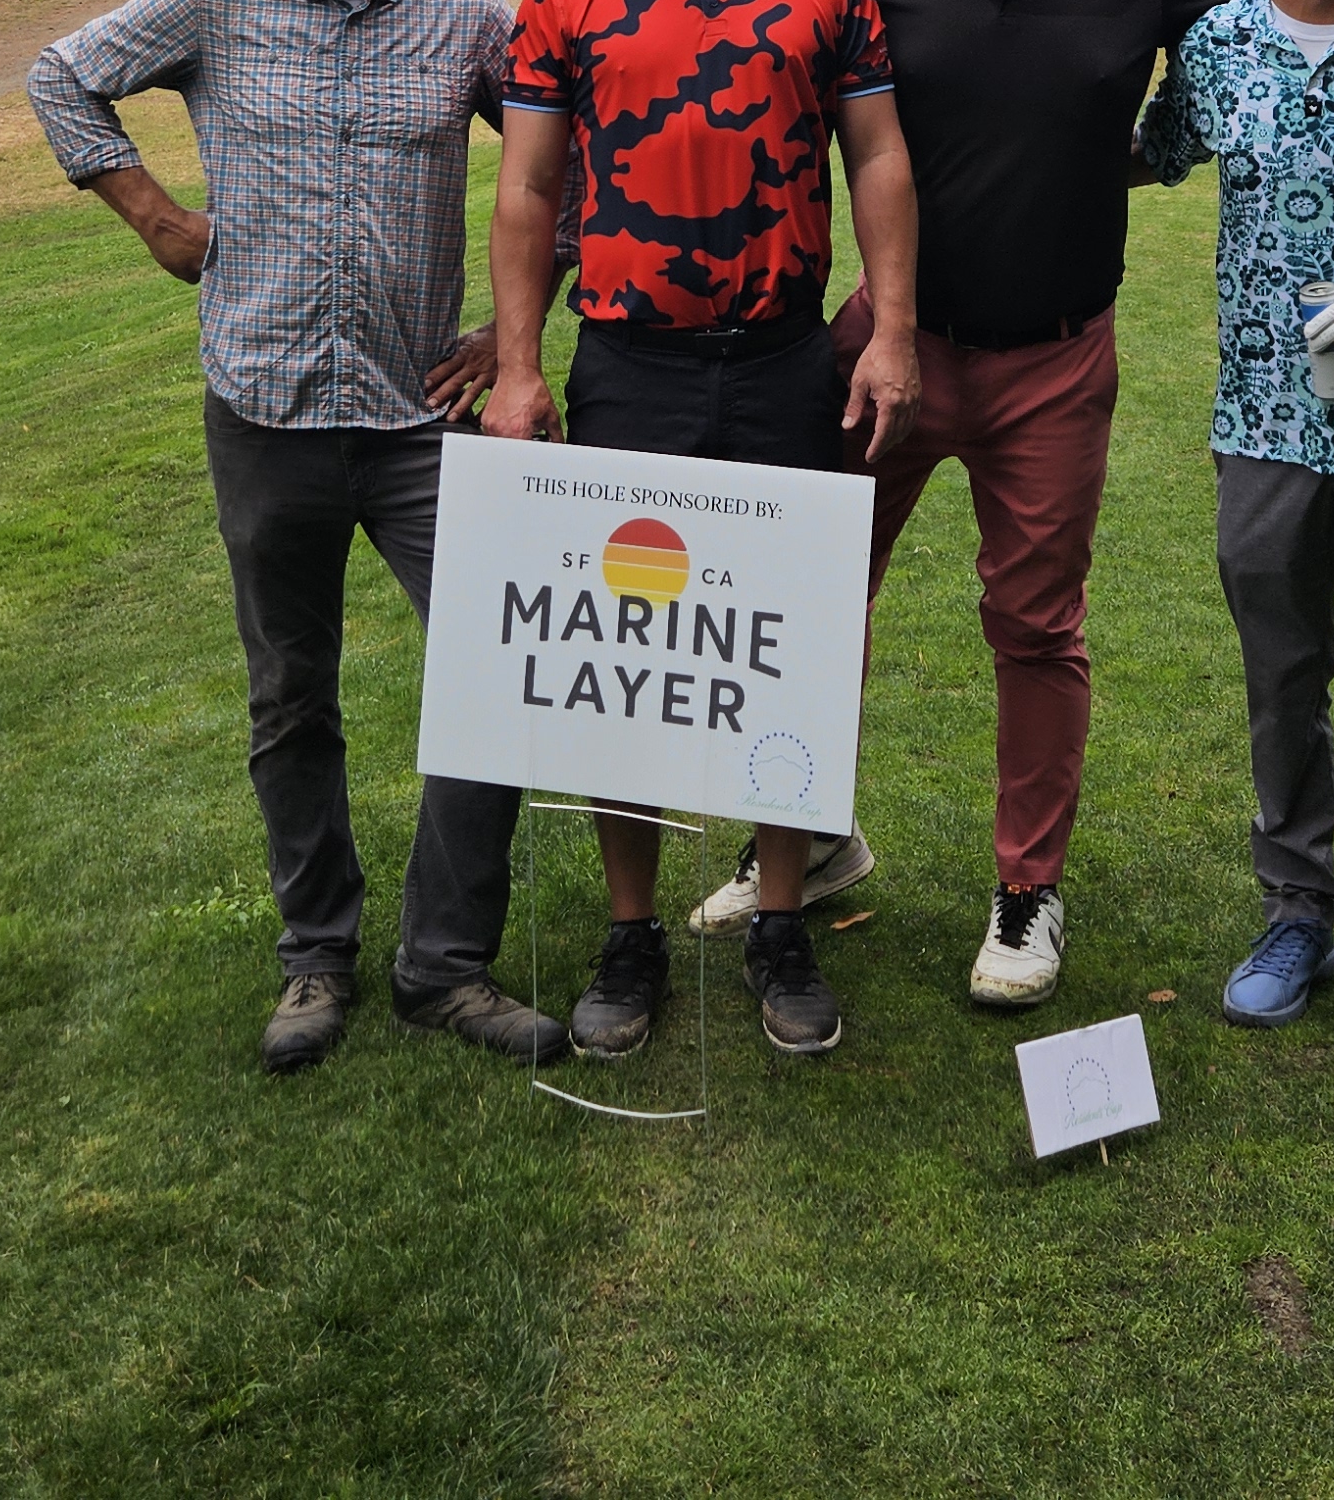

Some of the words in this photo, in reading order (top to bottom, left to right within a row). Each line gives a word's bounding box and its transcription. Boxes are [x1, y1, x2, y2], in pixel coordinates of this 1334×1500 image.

[523, 476, 567, 496] THIS
[572, 481, 626, 502] HOLE
[630, 487, 749, 516] SPONSORED
[755, 501, 783, 520] BY:
[562, 552, 591, 569] SF
[701, 568, 733, 587] CA
[501, 581, 784, 679] MARINE
[523, 654, 746, 733] LAYER
